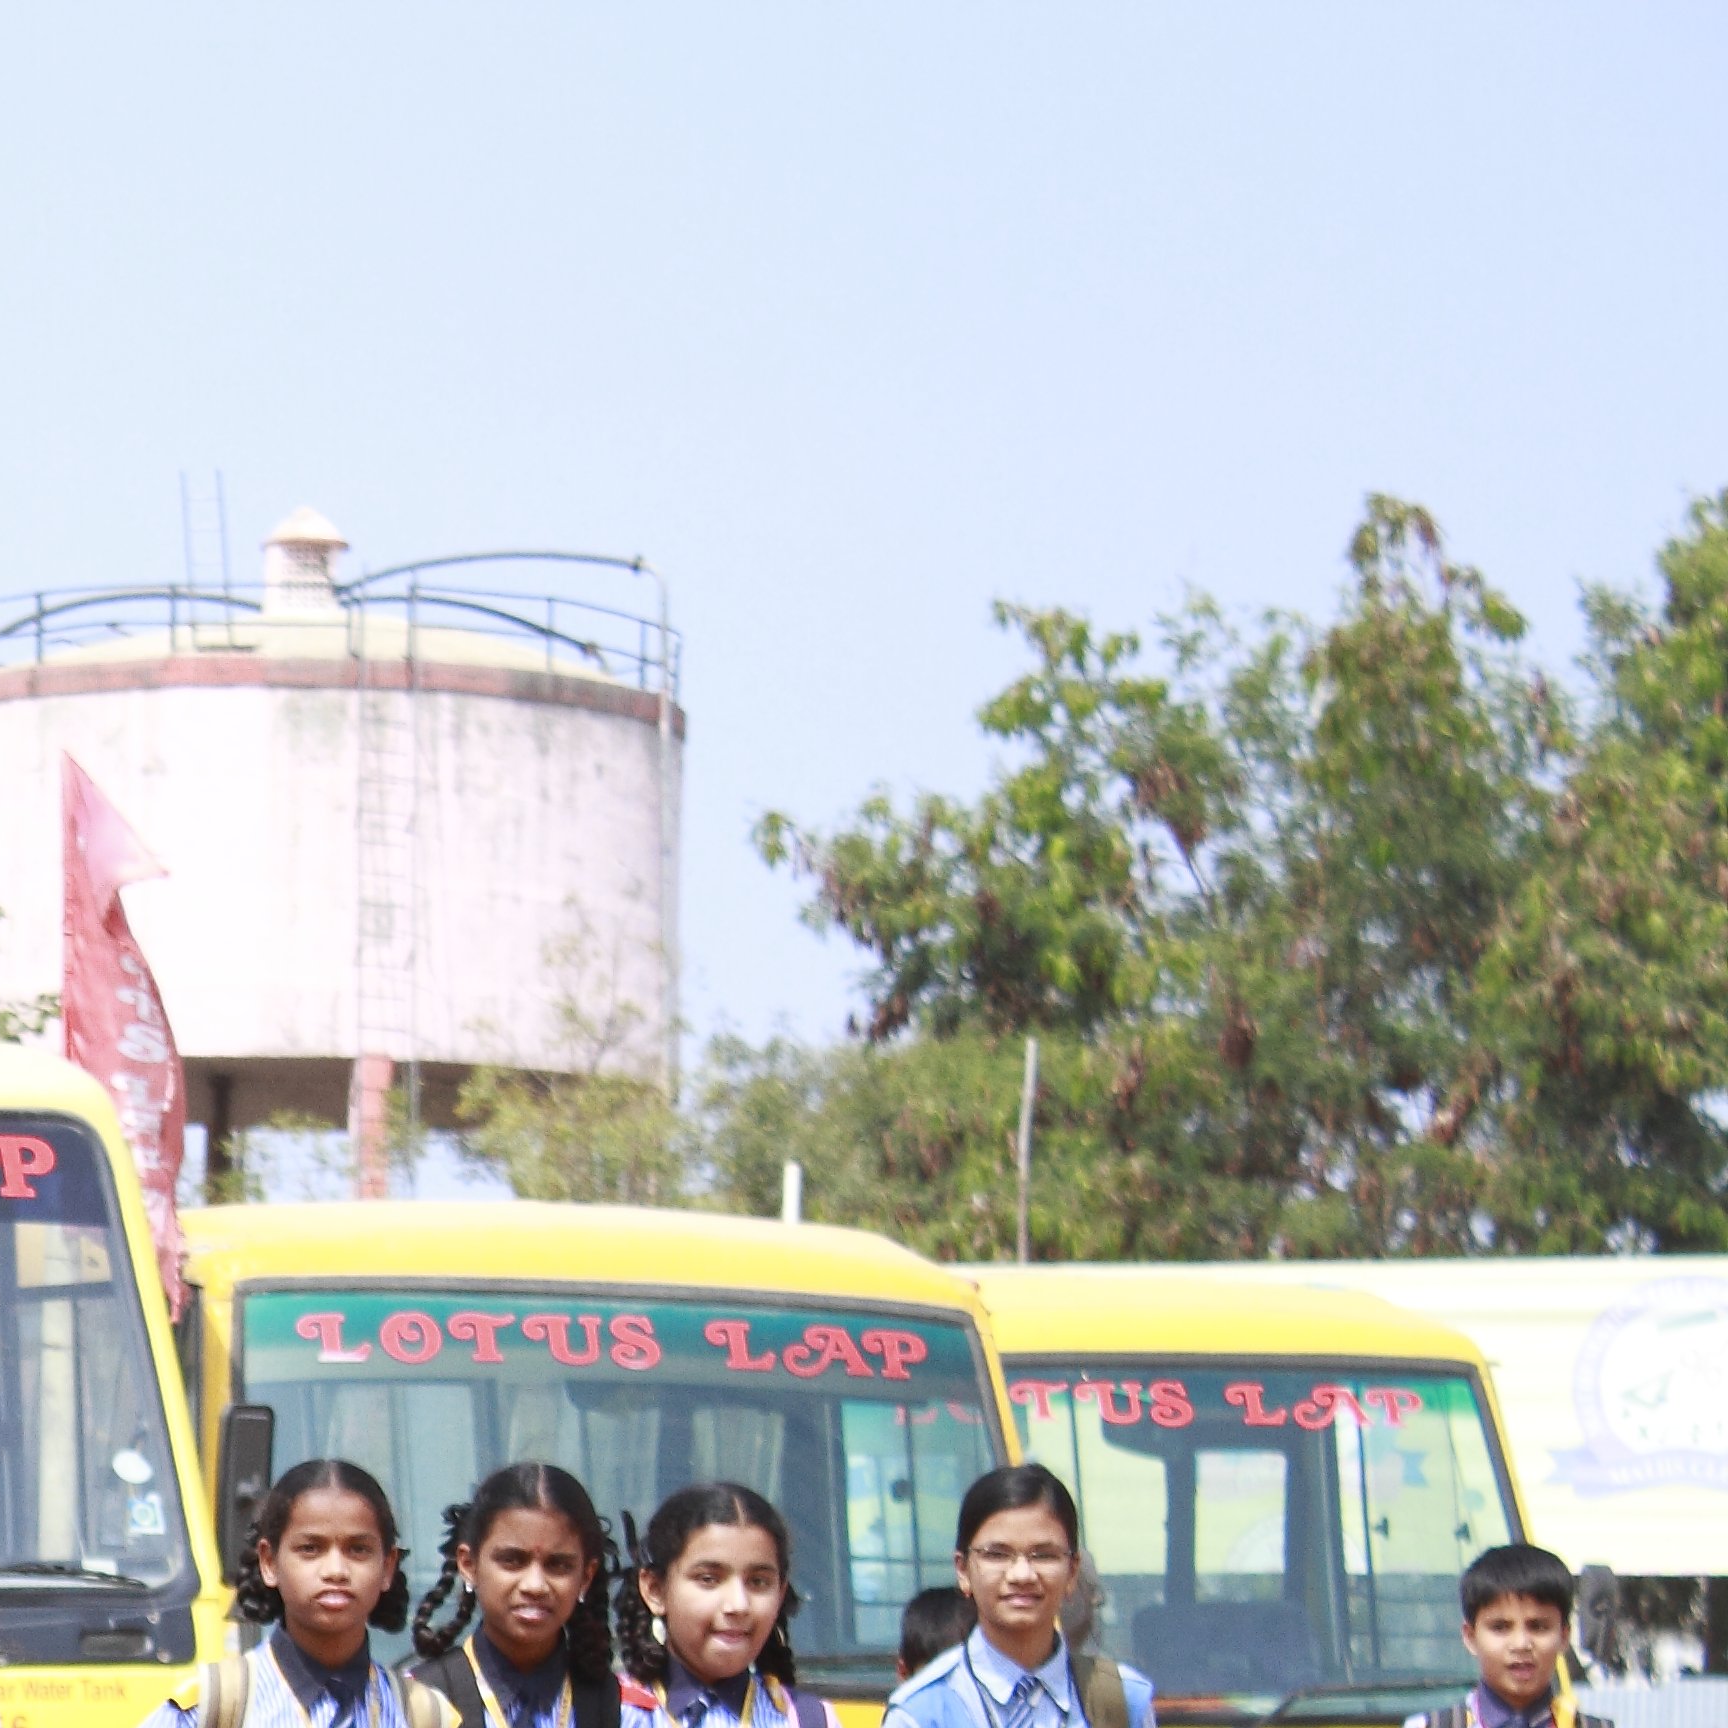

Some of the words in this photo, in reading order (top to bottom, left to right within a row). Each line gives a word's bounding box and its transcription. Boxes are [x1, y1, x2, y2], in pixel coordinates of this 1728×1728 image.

[295, 1310, 663, 1371] LOTUS
[704, 1319, 930, 1382] LAP
[1224, 1381, 1424, 1430] LAP
[21, 1679, 73, 1701] Water
[80, 1678, 128, 1701] Tank
